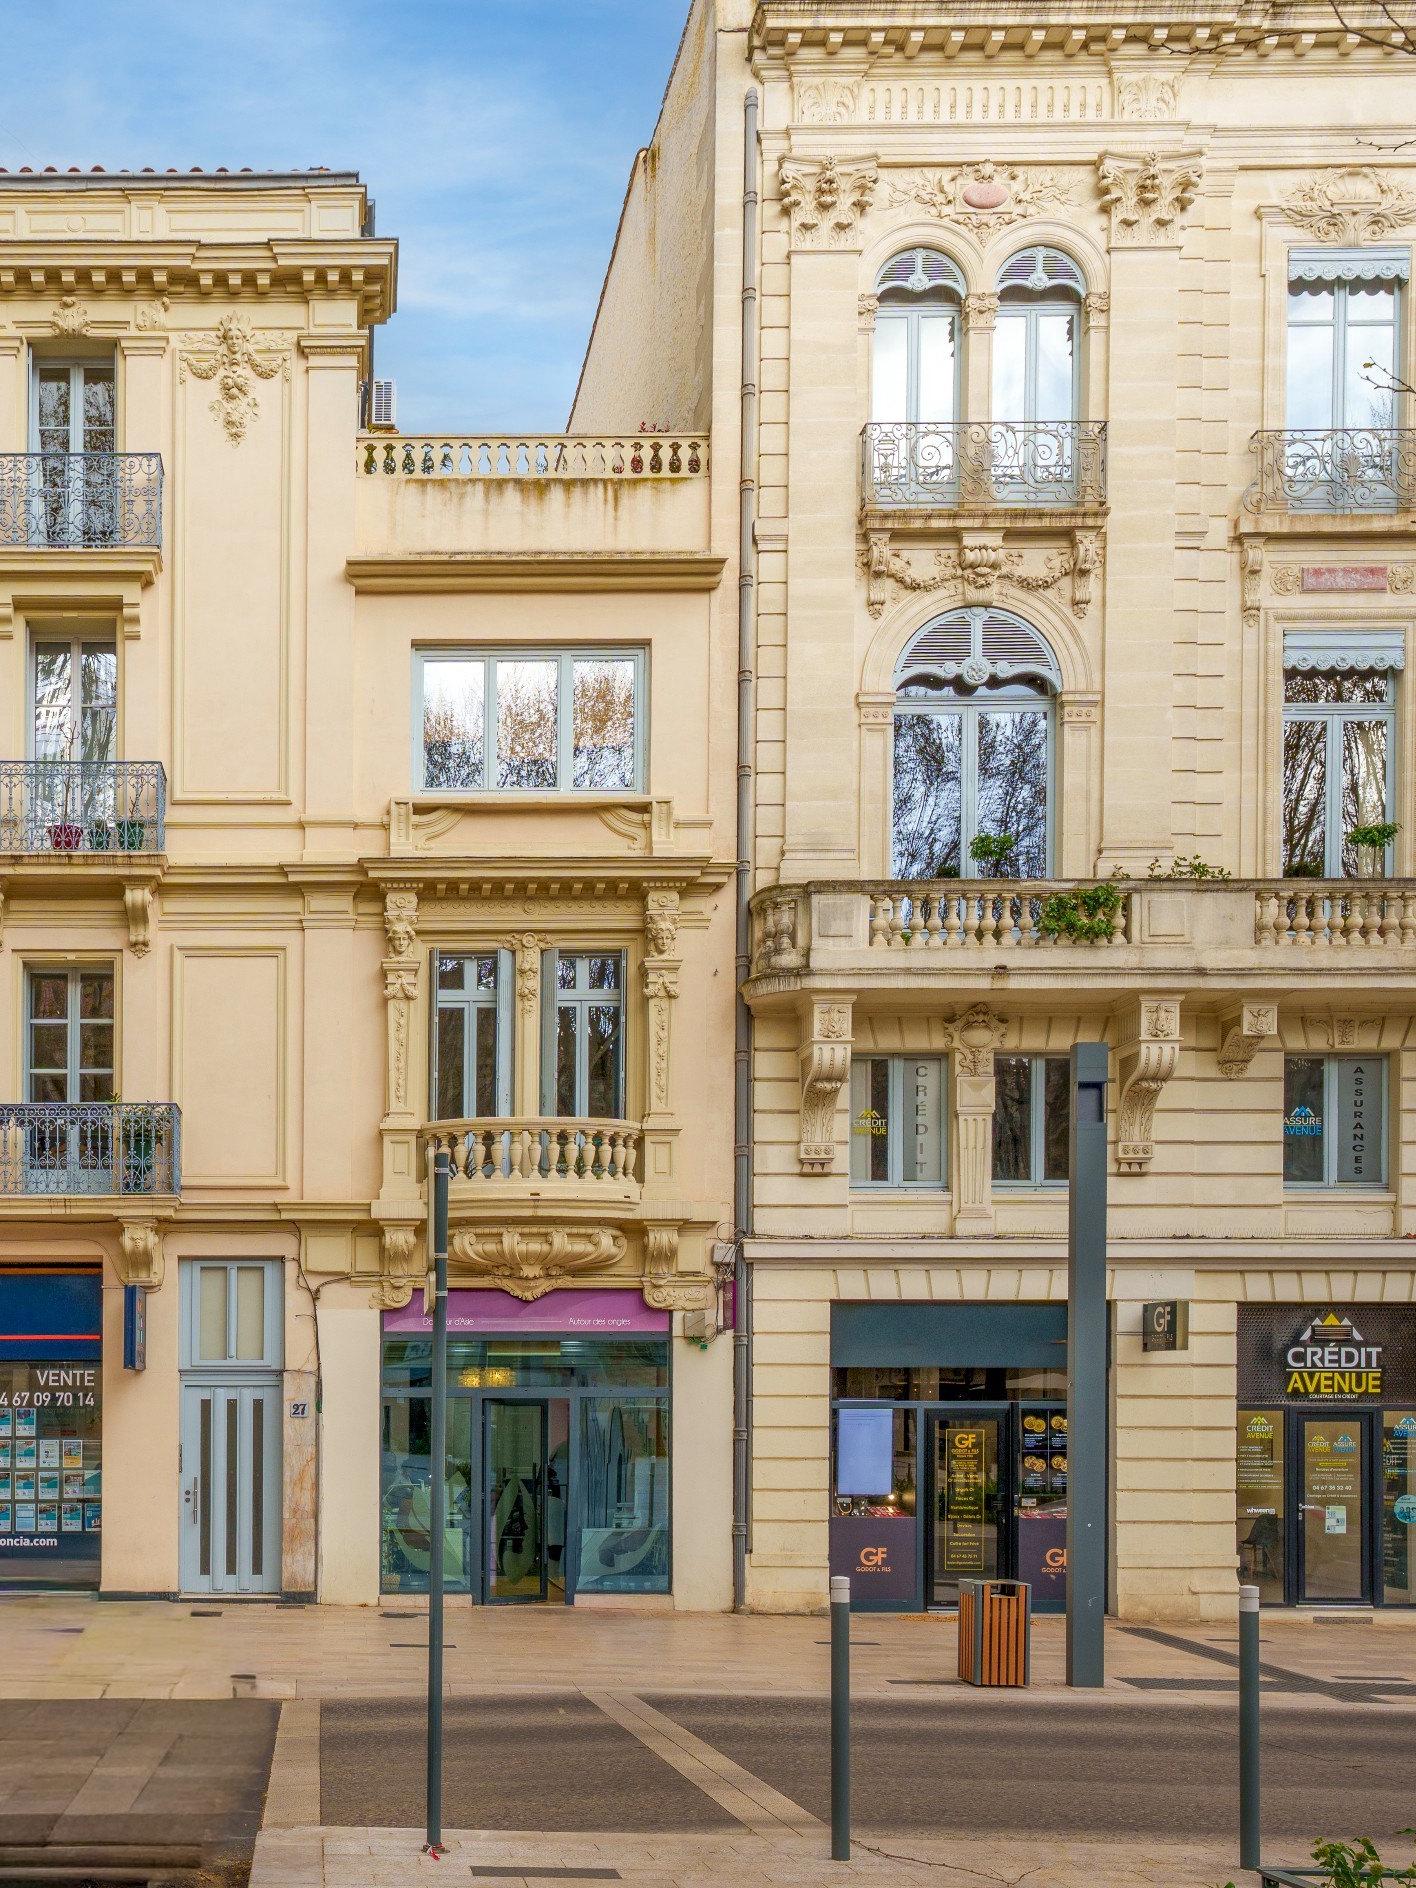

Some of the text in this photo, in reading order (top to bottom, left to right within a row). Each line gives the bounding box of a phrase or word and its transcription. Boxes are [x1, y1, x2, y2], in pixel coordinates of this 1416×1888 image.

[853, 1117, 887, 1127] CRÉDIT
[915, 1065, 929, 1174] CRÉDIT
[1283, 1117, 1322, 1125] ASSURE
[1352, 1066, 1364, 1175] ASSURANCES
[1284, 1126, 1322, 1135] AVENUE
[422, 1318, 453, 1326] Dour
[608, 1318, 631, 1327] ongles
[1154, 1306, 1171, 1332] GF
[1287, 1342, 1383, 1368] CRÉDIT
[36, 1370, 95, 1386] VENTE
[1286, 1372, 1381, 1393] AVENUE
[12, 1392, 30, 1406] 67
[33, 1392, 51, 1406] 09
[55, 1392, 73, 1406] 70
[77, 1392, 95, 1406] 14
[292, 1404, 307, 1415] 27
[1246, 1424, 1273, 1432] CRÉDIT
[954, 1433, 976, 1448] GF
[860, 1547, 887, 1566] GF
